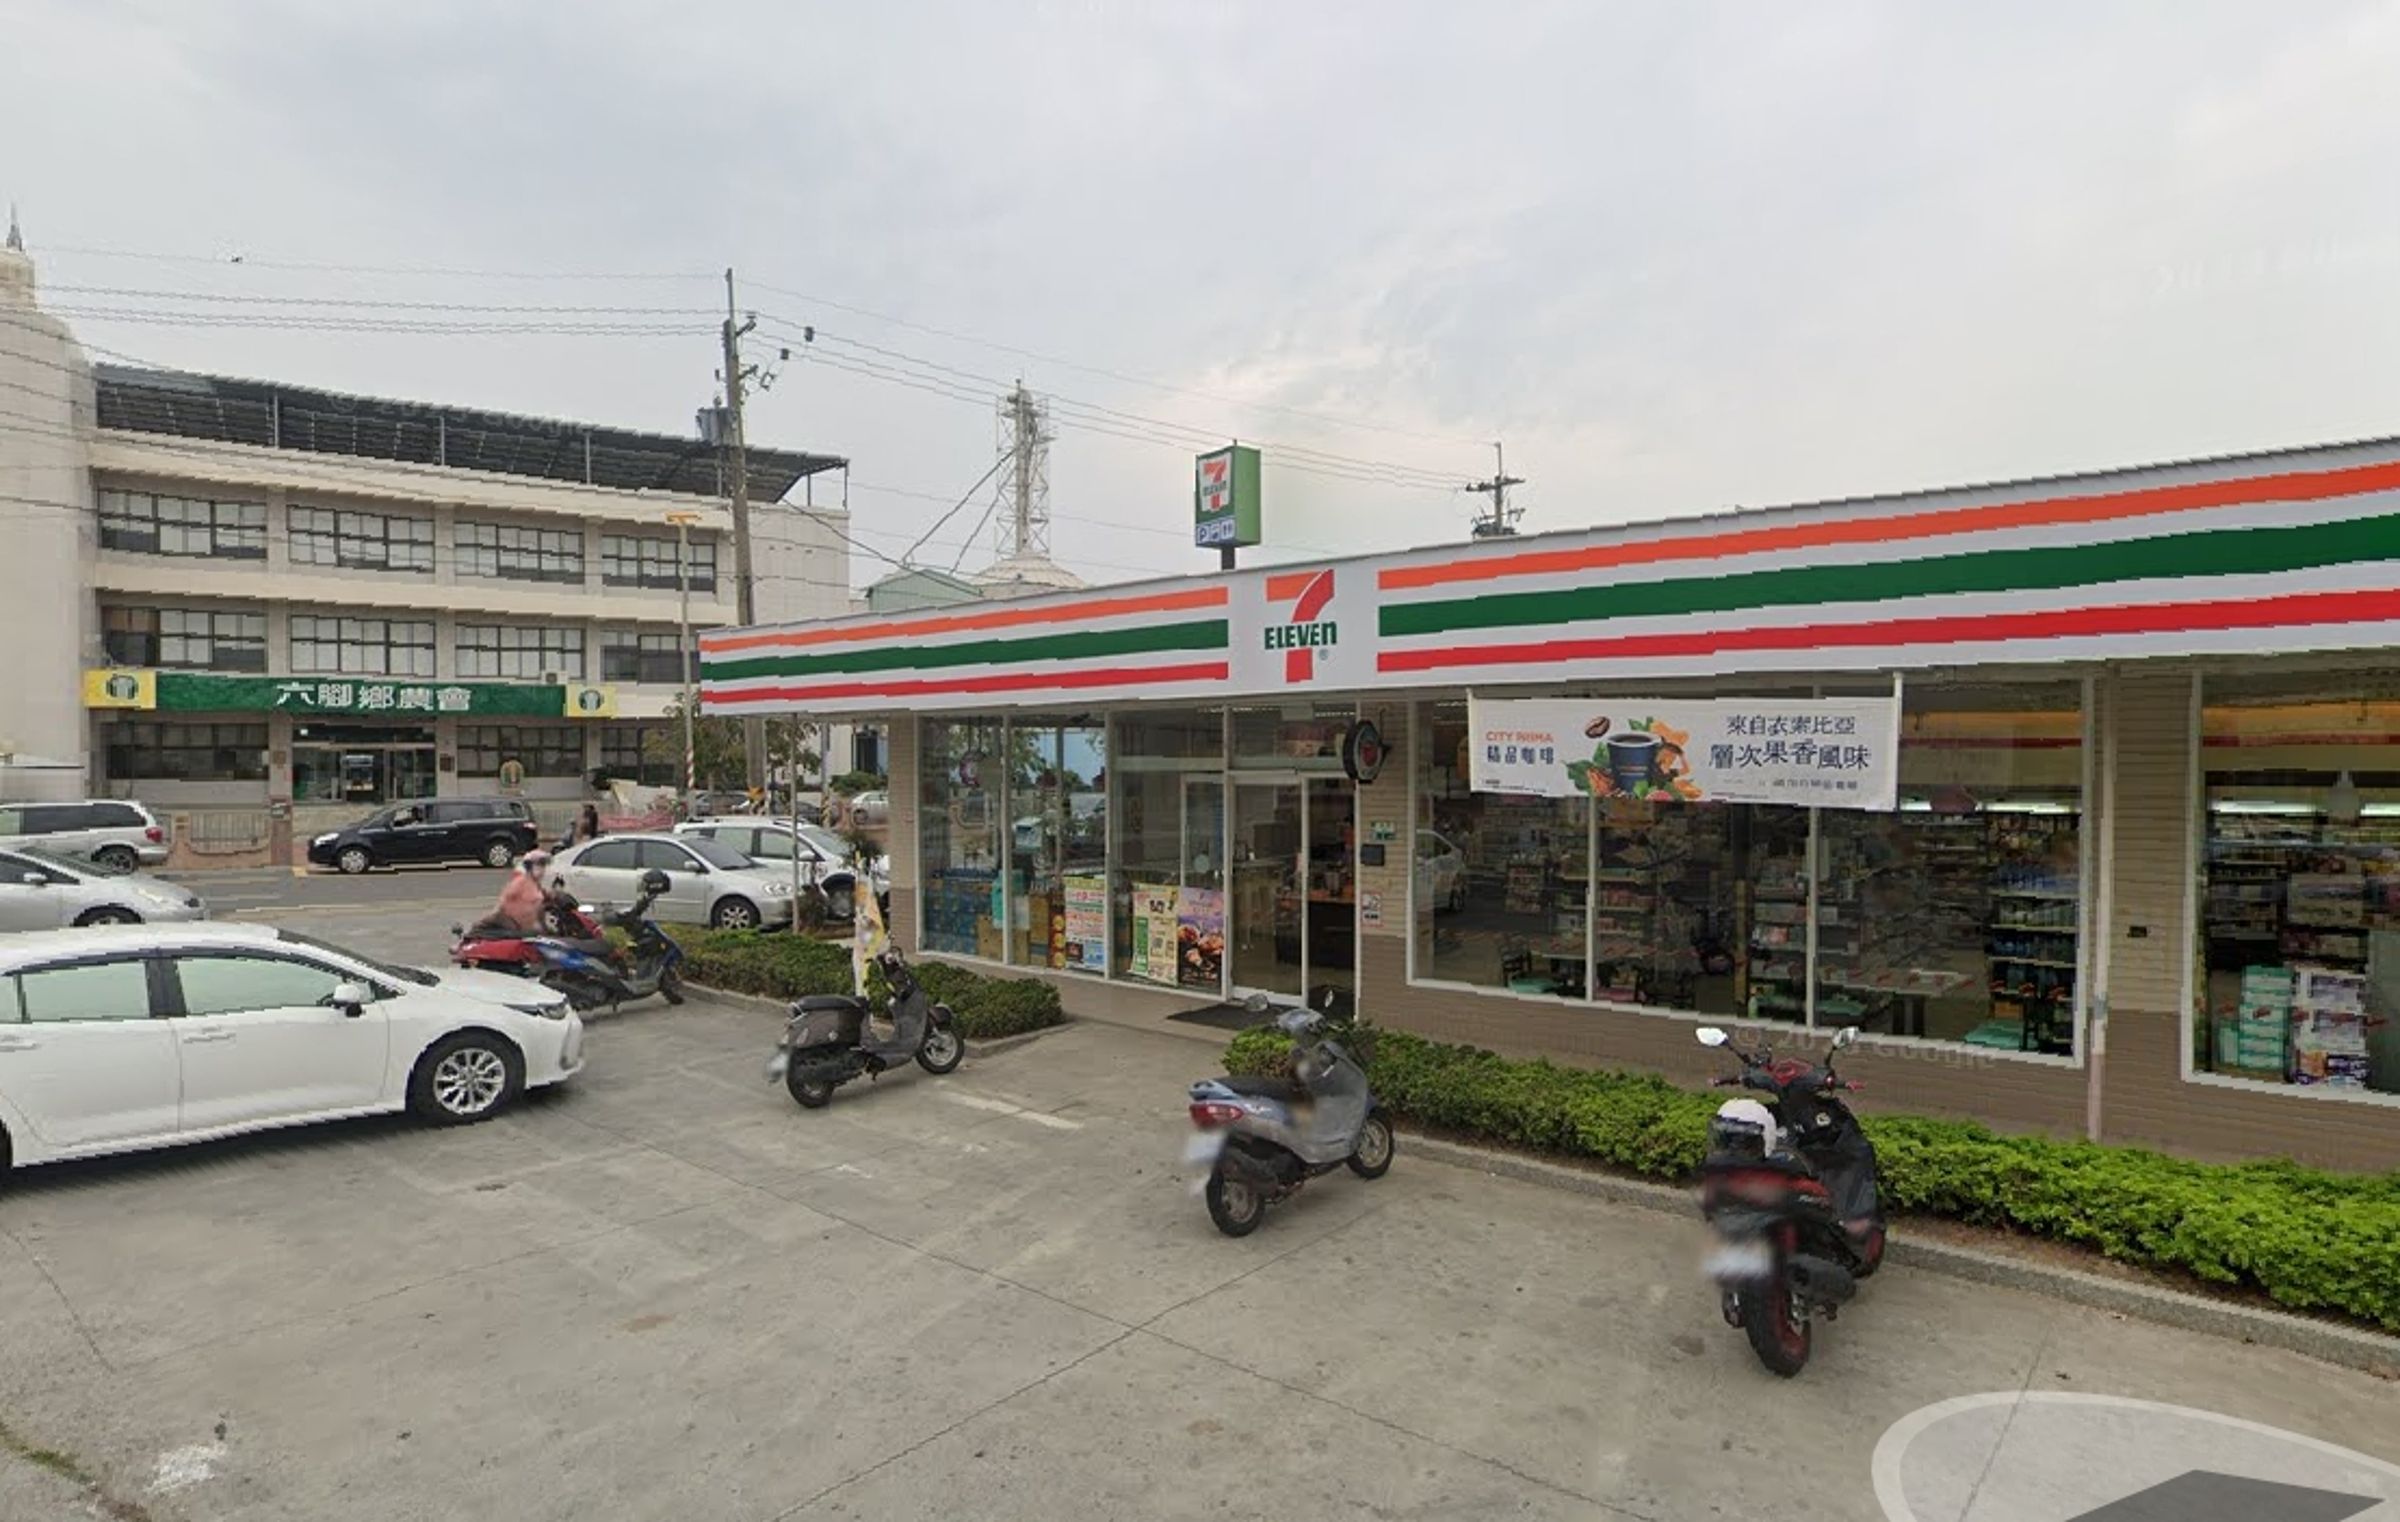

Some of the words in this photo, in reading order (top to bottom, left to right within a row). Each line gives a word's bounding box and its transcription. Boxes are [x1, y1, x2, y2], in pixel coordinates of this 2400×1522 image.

[1266, 569, 1334, 683] 7
[276, 682, 472, 711] 六腳鄉農會
[1486, 731, 1513, 742] CITY
[1727, 715, 1856, 736] 來自衣索比亞
[1709, 738, 1872, 770] 層次果香風味
